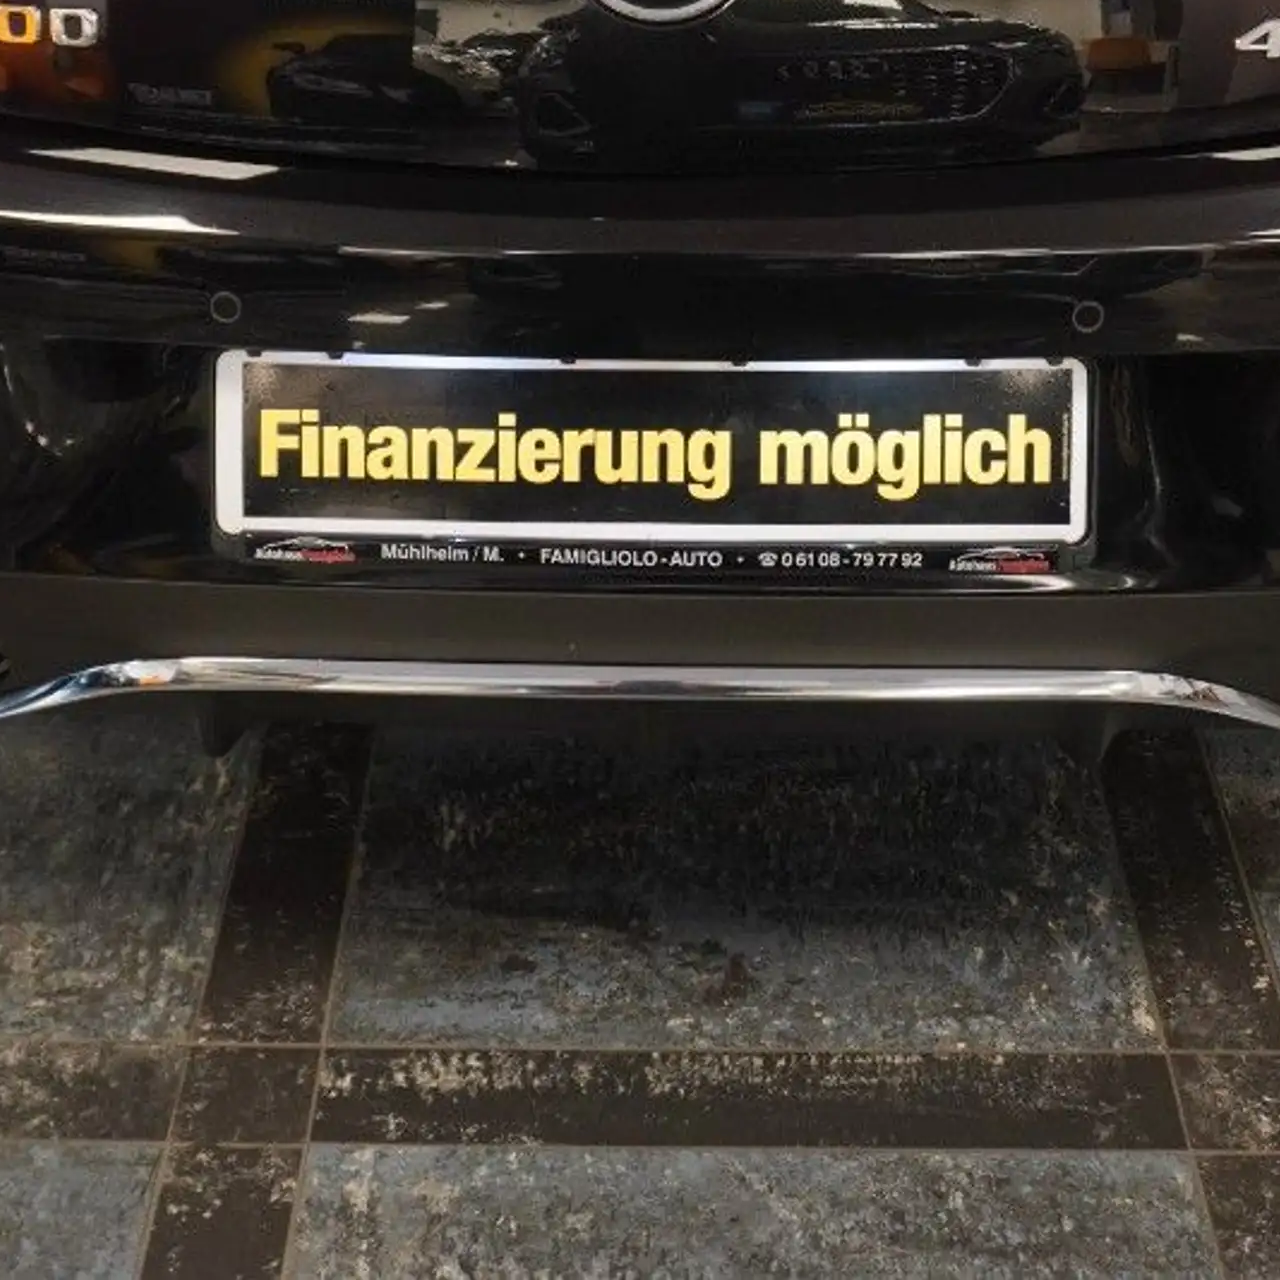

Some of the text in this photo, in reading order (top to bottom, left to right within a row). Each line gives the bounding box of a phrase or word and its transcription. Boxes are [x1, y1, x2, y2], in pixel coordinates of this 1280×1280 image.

[259, 408, 732, 500] Finanzierung
[759, 413, 1052, 501] möglich
[381, 543, 469, 561] Mühlheim
